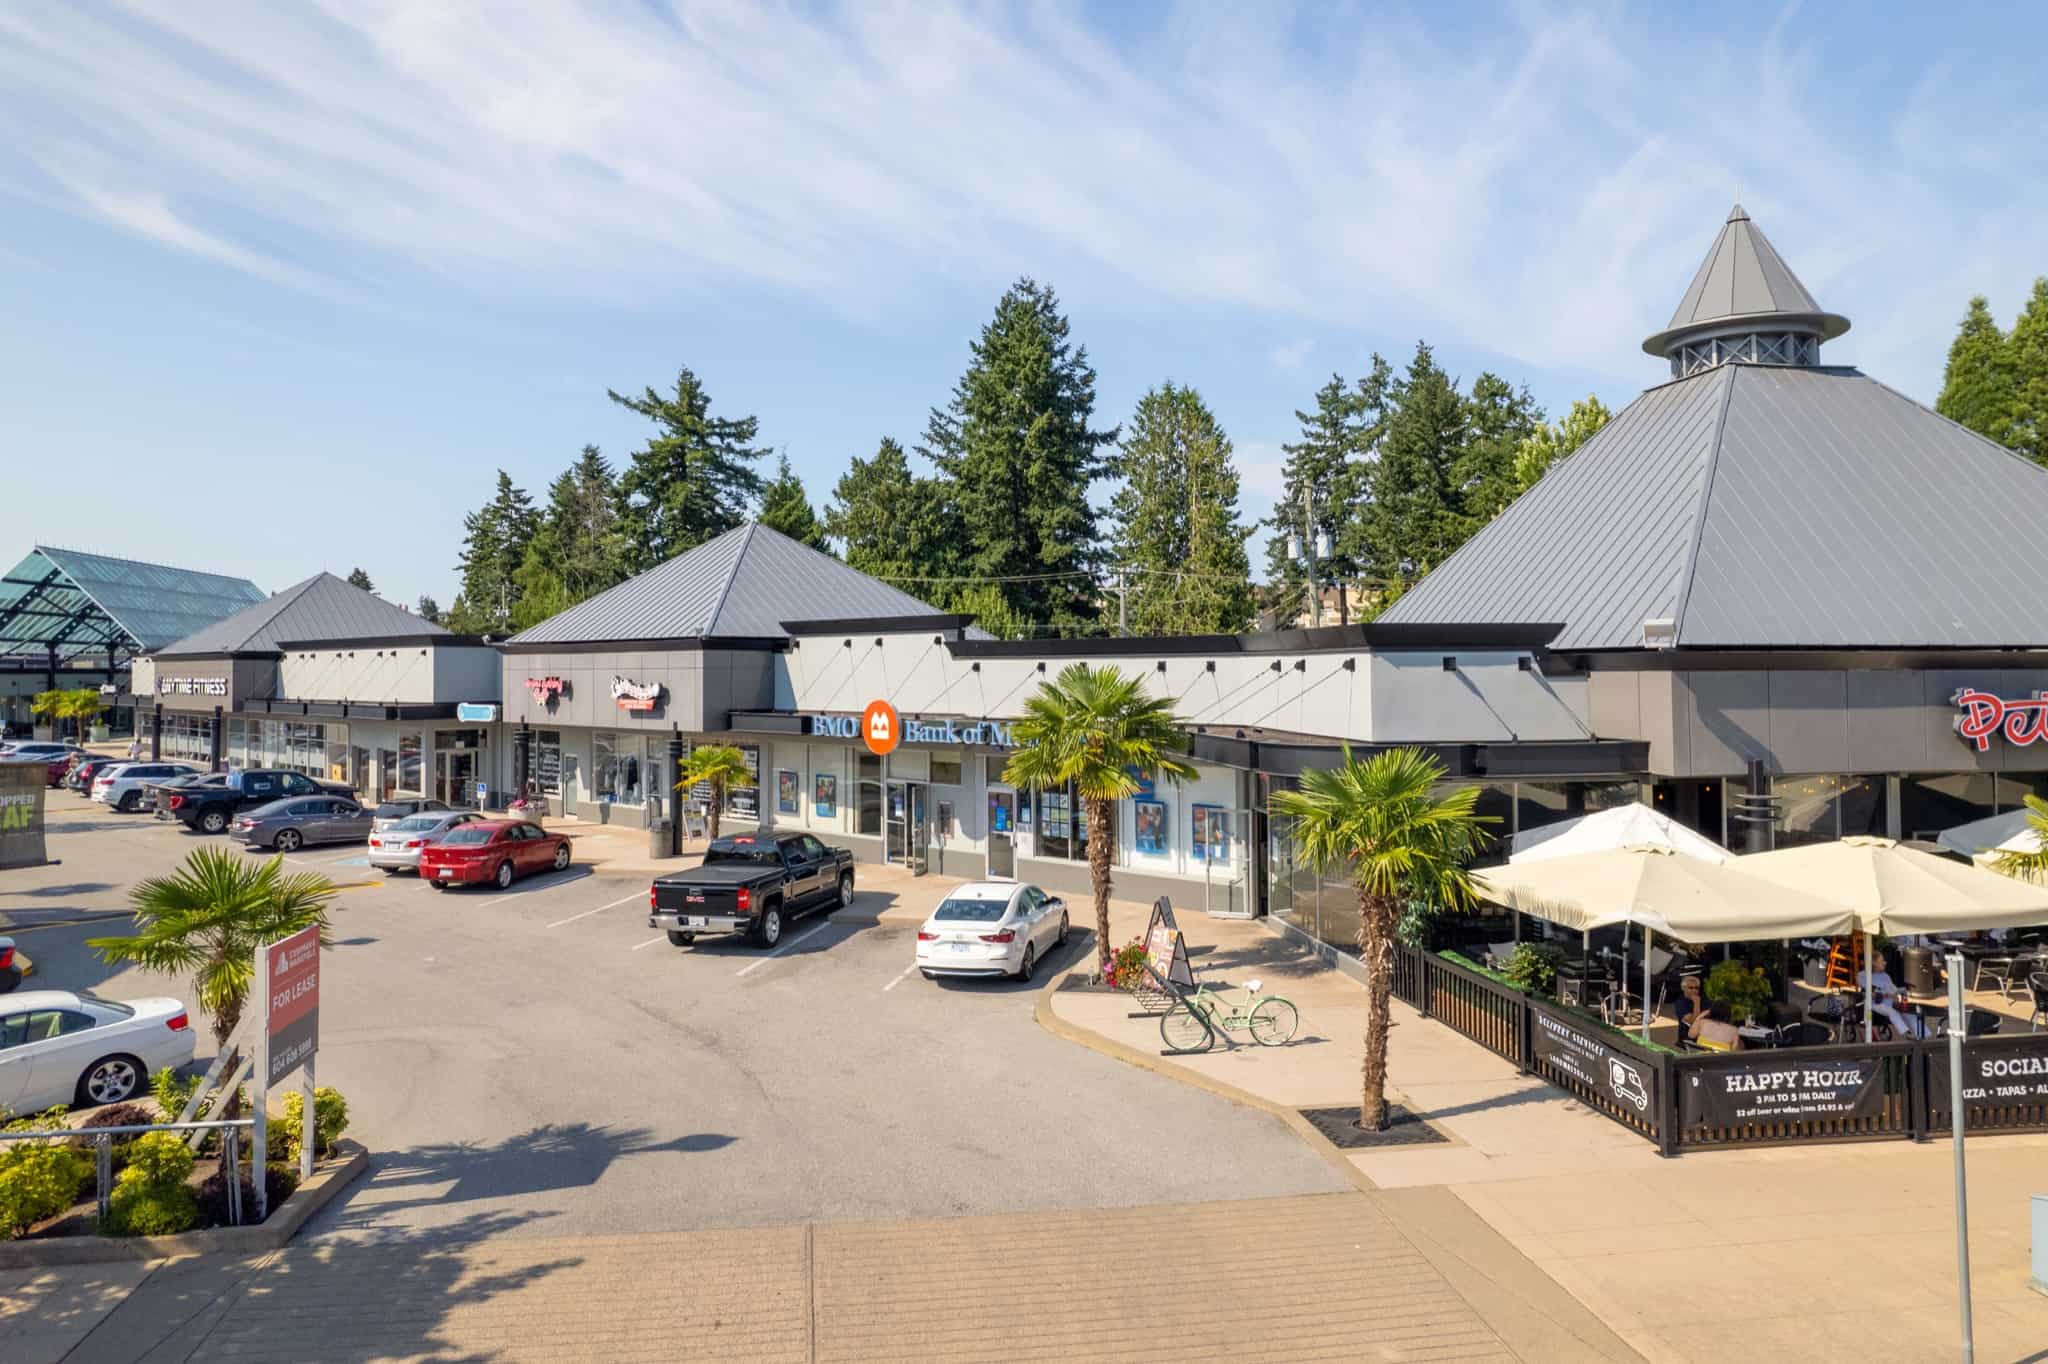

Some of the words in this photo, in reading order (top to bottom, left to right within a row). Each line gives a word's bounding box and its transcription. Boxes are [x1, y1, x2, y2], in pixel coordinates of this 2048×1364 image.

[193, 677, 227, 695] FITNESS
[811, 715, 857, 738] BMO
[904, 720, 961, 744] Bank
[963, 721, 987, 745] of
[272, 989, 290, 1012] FOR
[292, 974, 317, 1000] LEASE
[1726, 1072, 1798, 1092] HAPPY
[1803, 1070, 1863, 1087] HOUR
[1777, 1093, 1788, 1102] TO
[1812, 1092, 1836, 1101] DAILY
[1962, 1087, 1986, 1099] IZZA
[1995, 1085, 2027, 1097] TAPAS
